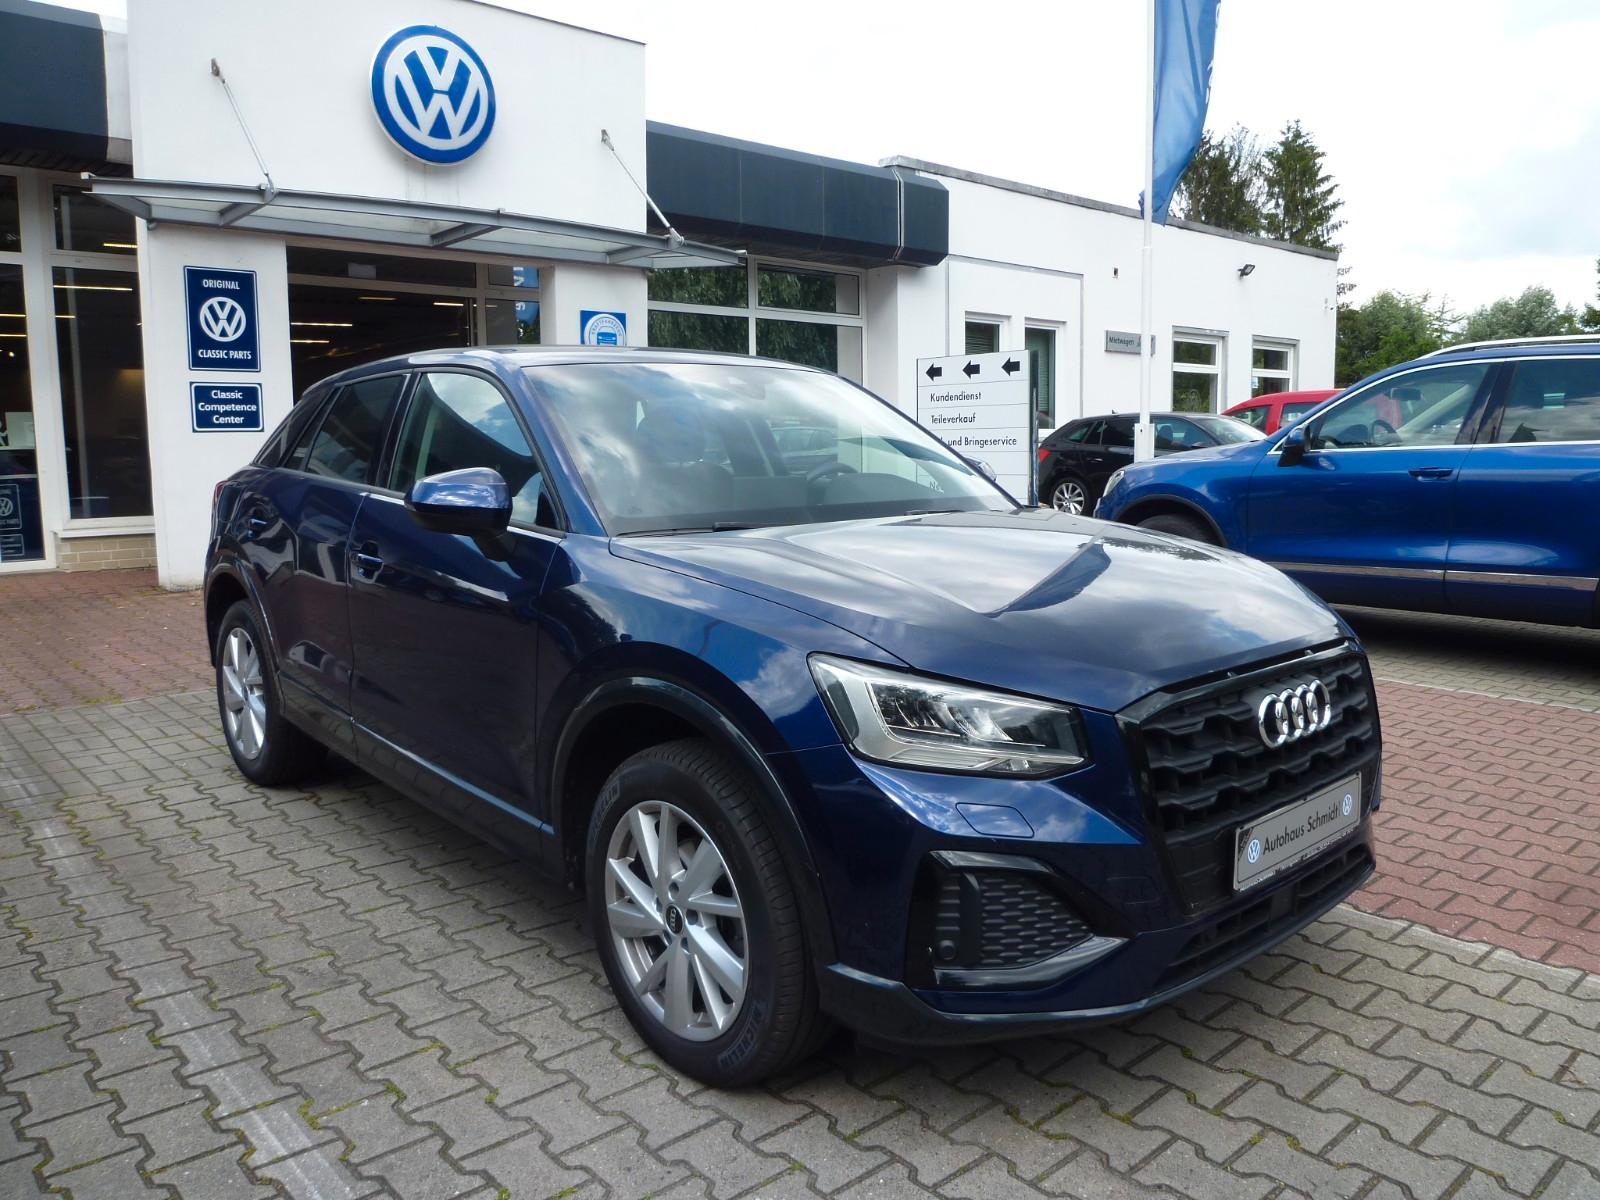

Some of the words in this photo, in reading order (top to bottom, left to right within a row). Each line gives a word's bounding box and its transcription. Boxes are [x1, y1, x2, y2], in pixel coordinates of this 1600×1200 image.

[383, 34, 489, 150] VW
[202, 279, 240, 290] ORIGINAL
[200, 296, 246, 342] VW
[198, 349, 228, 359] CLASSIC
[229, 350, 252, 360] PARTS
[211, 390, 243, 399] Classic
[930, 391, 982, 402] Kundendienst
[198, 402, 257, 413] Competence
[213, 415, 245, 424] Center
[931, 412, 976, 424] Teileverkauf
[948, 436, 962, 447] und
[964, 436, 1017, 448] Bringeservice
[1262, 824, 1305, 855] Autohaus
[1307, 804, 1339, 833] Schmidt
